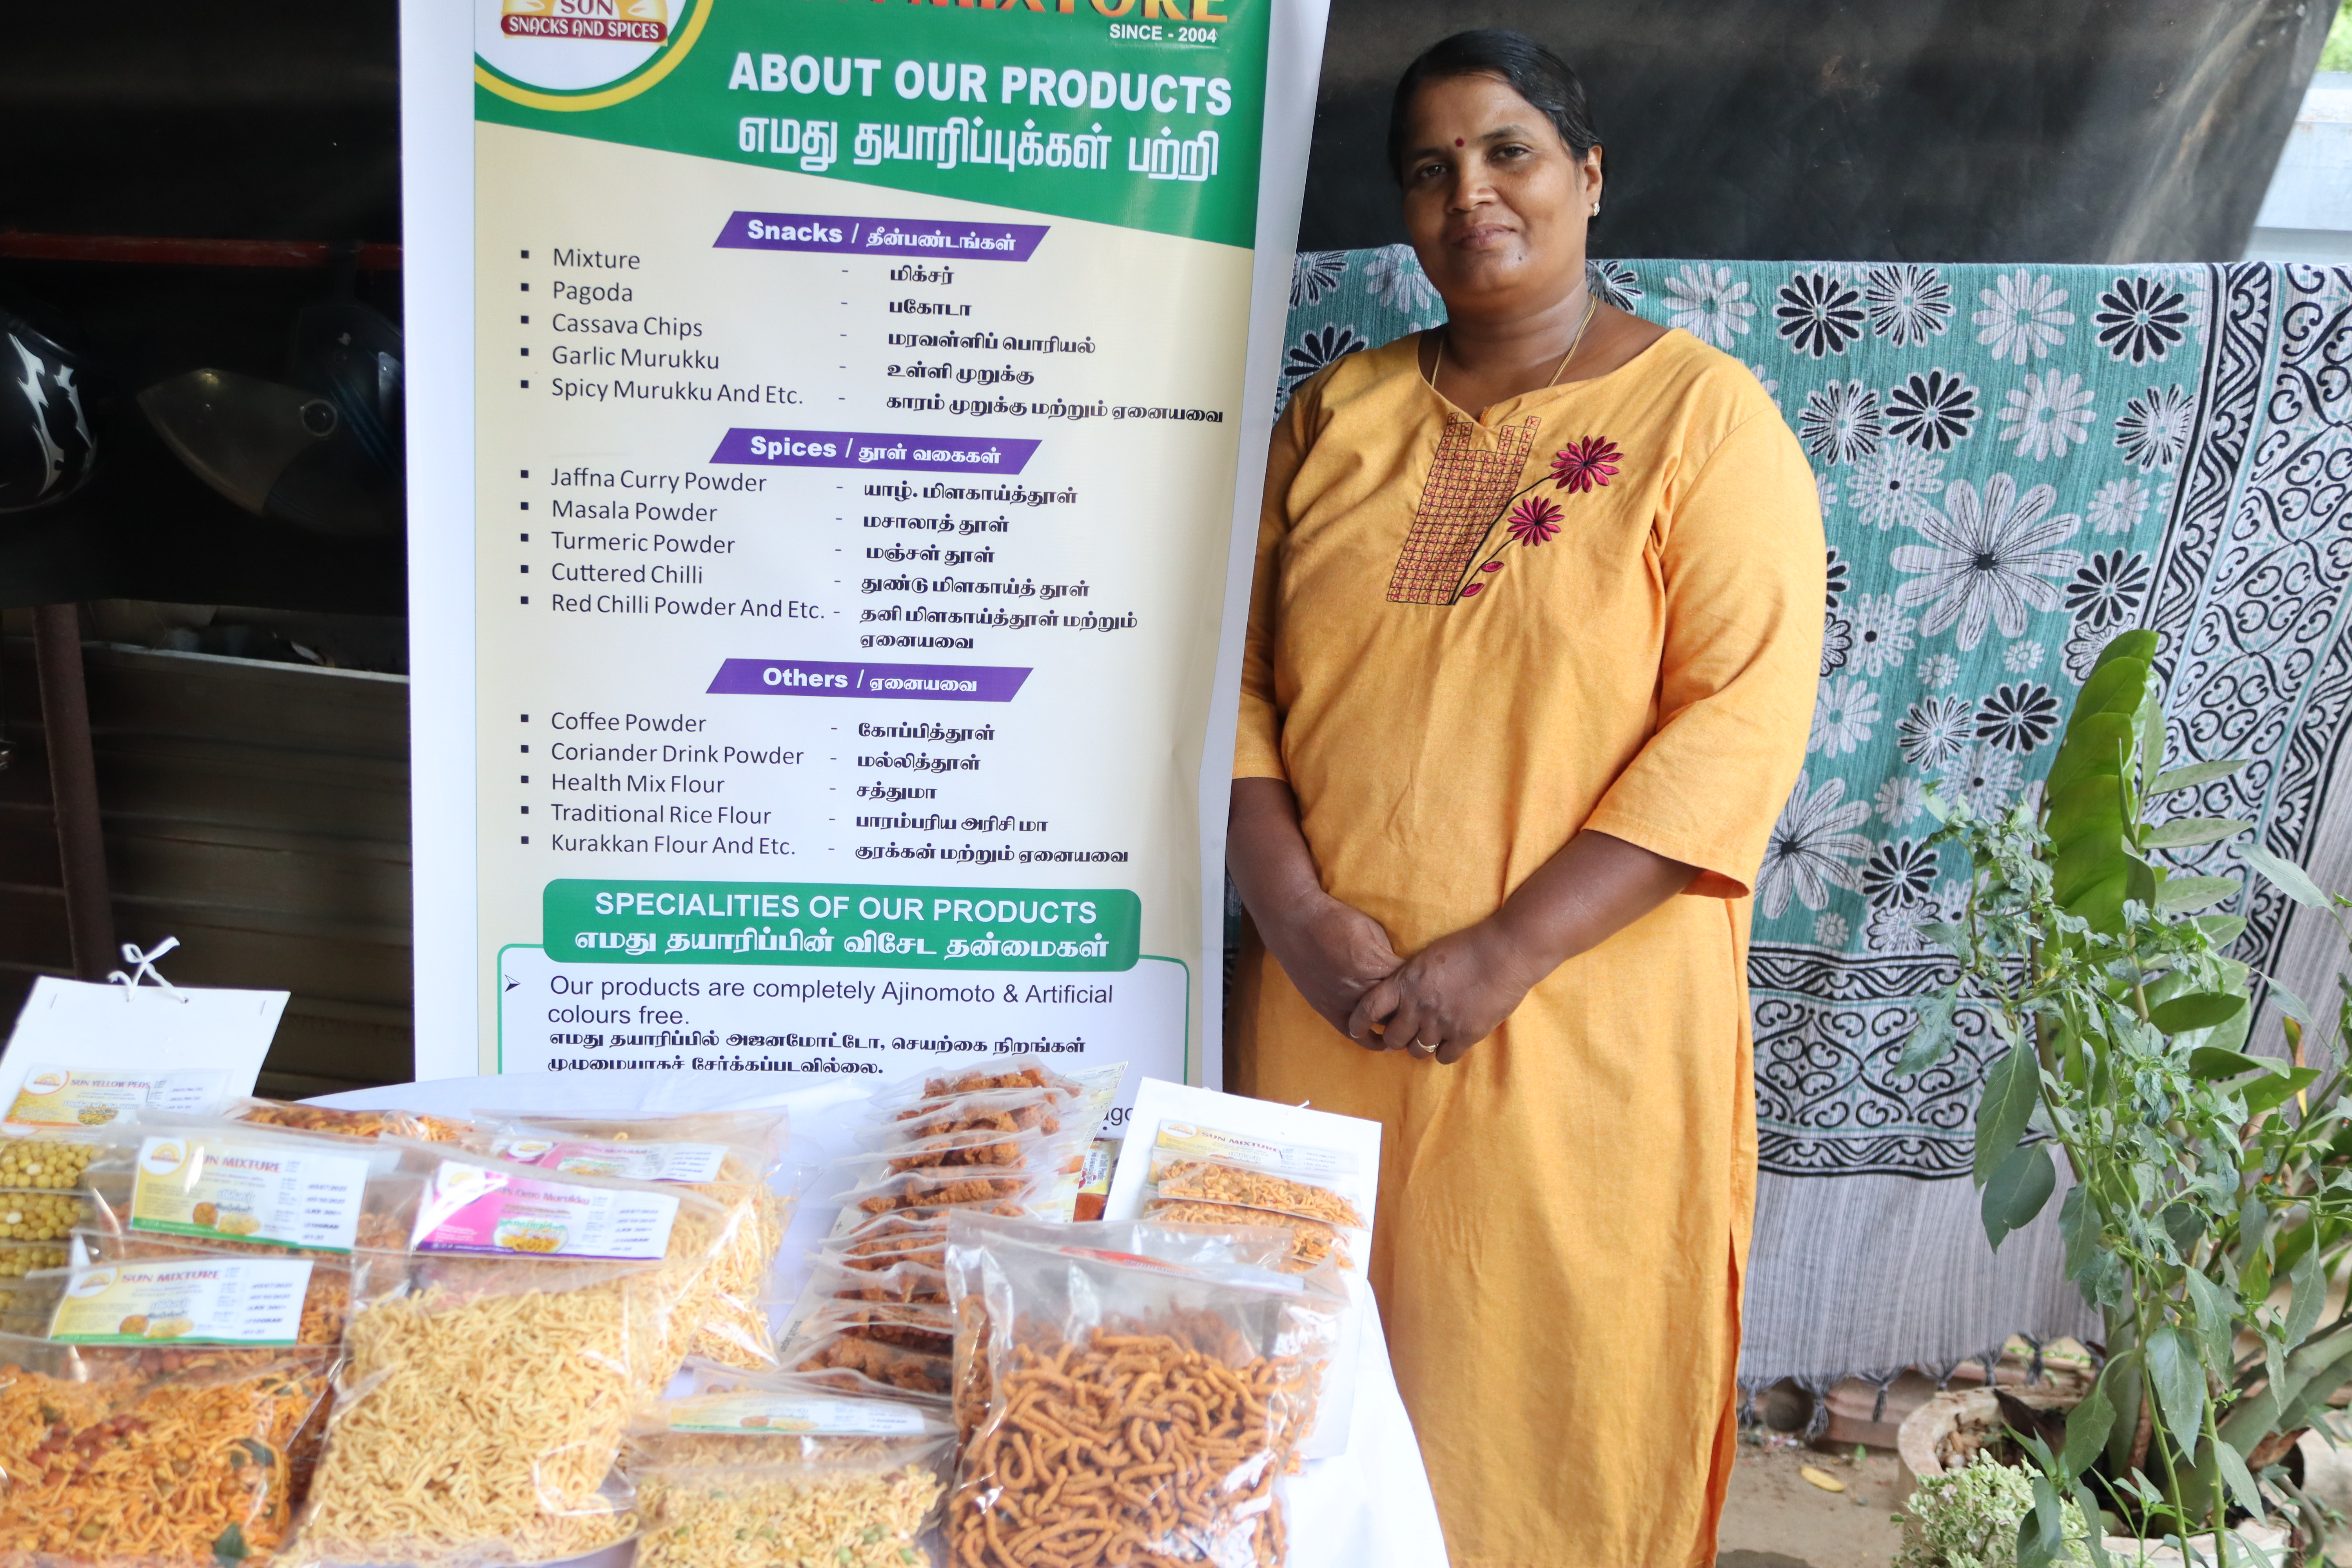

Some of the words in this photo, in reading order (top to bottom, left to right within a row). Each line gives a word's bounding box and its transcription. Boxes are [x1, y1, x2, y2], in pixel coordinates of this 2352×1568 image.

[510, 16, 568, 35] SNACKS
[573, 20, 604, 37] AND
[608, 22, 658, 39] SPICES
[1110, 24, 1162, 40] SINCE
[1178, 27, 1218, 42] 2004
[729, 53, 881, 96] ABOUT
[895, 61, 987, 102] OUR
[1002, 67, 1231, 115] PRODUCTS
[740, 117, 837, 171] எமது
[1129, 126, 1218, 181] பற்றி
[748, 220, 842, 243] Snacks
[554, 249, 640, 269] Mixture
[891, 265, 954, 285] மிக்சர்
[554, 281, 632, 305] Pagoda
[890, 299, 971, 316] பகோடா
[553, 314, 637, 334] Cassava
[644, 317, 702, 340] Chips
[889, 330, 998, 348] மரவள்ளிப்
[1003, 336, 1095, 353] பொரியல்
[553, 346, 615, 365] Garlic
[622, 348, 718, 369] Murukku
[887, 361, 951, 378] உள்ளி
[956, 365, 1034, 385] முறுக்கு
[552, 378, 608, 401] Spicy
[615, 381, 711, 401] Murukku
[717, 385, 759, 402] And
[767, 386, 802, 404] Etc.
[887, 393, 944, 411] காரம்
[949, 396, 1027, 416] முறுக்கு
[1032, 398, 1107, 420] மற்றும்
[1112, 407, 1223, 423] ஏனையவை
[751, 436, 836, 459] Spices
[858, 443, 907, 463] தூள்
[913, 447, 1001, 463] வகைகள்
[551, 468, 614, 487] Jaffna
[621, 470, 679, 494] Curry
[686, 472, 766, 491] Powder
[924, 483, 1077, 506] மிளகாய்த்தூள்
[554, 500, 628, 519] Masala
[636, 503, 717, 521] Powder
[864, 514, 955, 533] மசாலாத்
[959, 515, 1009, 535] தூள்
[552, 532, 648, 551] Turmeric
[655, 535, 735, 553] Powder
[867, 543, 940, 562] மஞ்சள்
[944, 546, 995, 566] தூள்
[552, 563, 644, 582] Cuttered
[652, 565, 702, 583] Chilli
[862, 574, 928, 593] துண்டு
[933, 577, 1035, 598] மிளகாய்த்
[1040, 580, 1089, 600] தூள்
[553, 594, 590, 612] Red
[598, 595, 648, 613] Chilli
[655, 597, 736, 615] Powder
[740, 600, 781, 617] And
[789, 601, 824, 618] Etc.
[860, 605, 901, 623] தனி
[906, 606, 1059, 629] மிளகாய்த்தூள்
[1064, 611, 1137, 632] மற்றும்
[860, 635, 973, 648] ஏனையவை
[763, 668, 848, 688] Others
[870, 679, 976, 691] ஏனையவை
[552, 712, 619, 730] Coffee
[626, 714, 706, 732] Powder
[859, 722, 995, 743] கோப்பித்தூள்
[552, 743, 657, 762] Coriander
[664, 745, 718, 762] Drink
[725, 747, 804, 764] Powder
[858, 751, 980, 773] மல்லித்தூள்
[553, 773, 620, 791] Health
[628, 775, 665, 792] Mix
[672, 775, 724, 793] Flour
[857, 781, 937, 802] சத்துமா
[551, 804, 663, 822] Traditional
[671, 806, 712, 823] Rice
[719, 806, 771, 824] Flour
[857, 812, 956, 831] பாரம்பரிய
[961, 815, 1014, 833] அரிசி
[1020, 821, 1048, 831] மா
[553, 834, 648, 852] Kurakkan
[655, 835, 708, 853] Flour
[712, 837, 753, 854] And
[760, 838, 795, 855] Etc.
[855, 842, 936, 859] குரக்கன்
[941, 844, 1014, 864] மற்றும்
[1019, 851, 1128, 863] ஏனையவை
[595, 893, 799, 917] SPECIALITIES
[809, 896, 849, 918] OF
[859, 897, 924, 920] OUR
[934, 899, 1096, 924] PRODUCTS
[575, 933, 656, 955] எமது
[665, 926, 835, 955] தயாரிப்பின்
[844, 930, 936, 954] விசேட
[944, 932, 1109, 960] தன்மைகள்
[551, 976, 593, 995] Our
[602, 978, 699, 1000] products
[709, 982, 744, 996] are
[754, 980, 876, 1005] completely
[882, 982, 994, 1005] Ajinomoto
[1004, 984, 1018, 1002] &
[1025, 985, 1112, 1003] Artificial
[548, 1005, 630, 1024] colours
[639, 1006, 688, 1024] free.
[550, 1034, 603, 1049] எமது
[610, 1030, 719, 1048] தயாரிப்பில்
[892, 1035, 987, 1054] செயற்கை
[993, 1037, 1085, 1055] நிறங்கள்
[1201, 1131, 1226, 1142] SUN
[1229, 1138, 1280, 1153] MIXTURE
[223, 1157, 281, 1172] MIXTURE
[122, 1274, 153, 1283] SUN
[157, 1270, 220, 1282] MIXTURE
